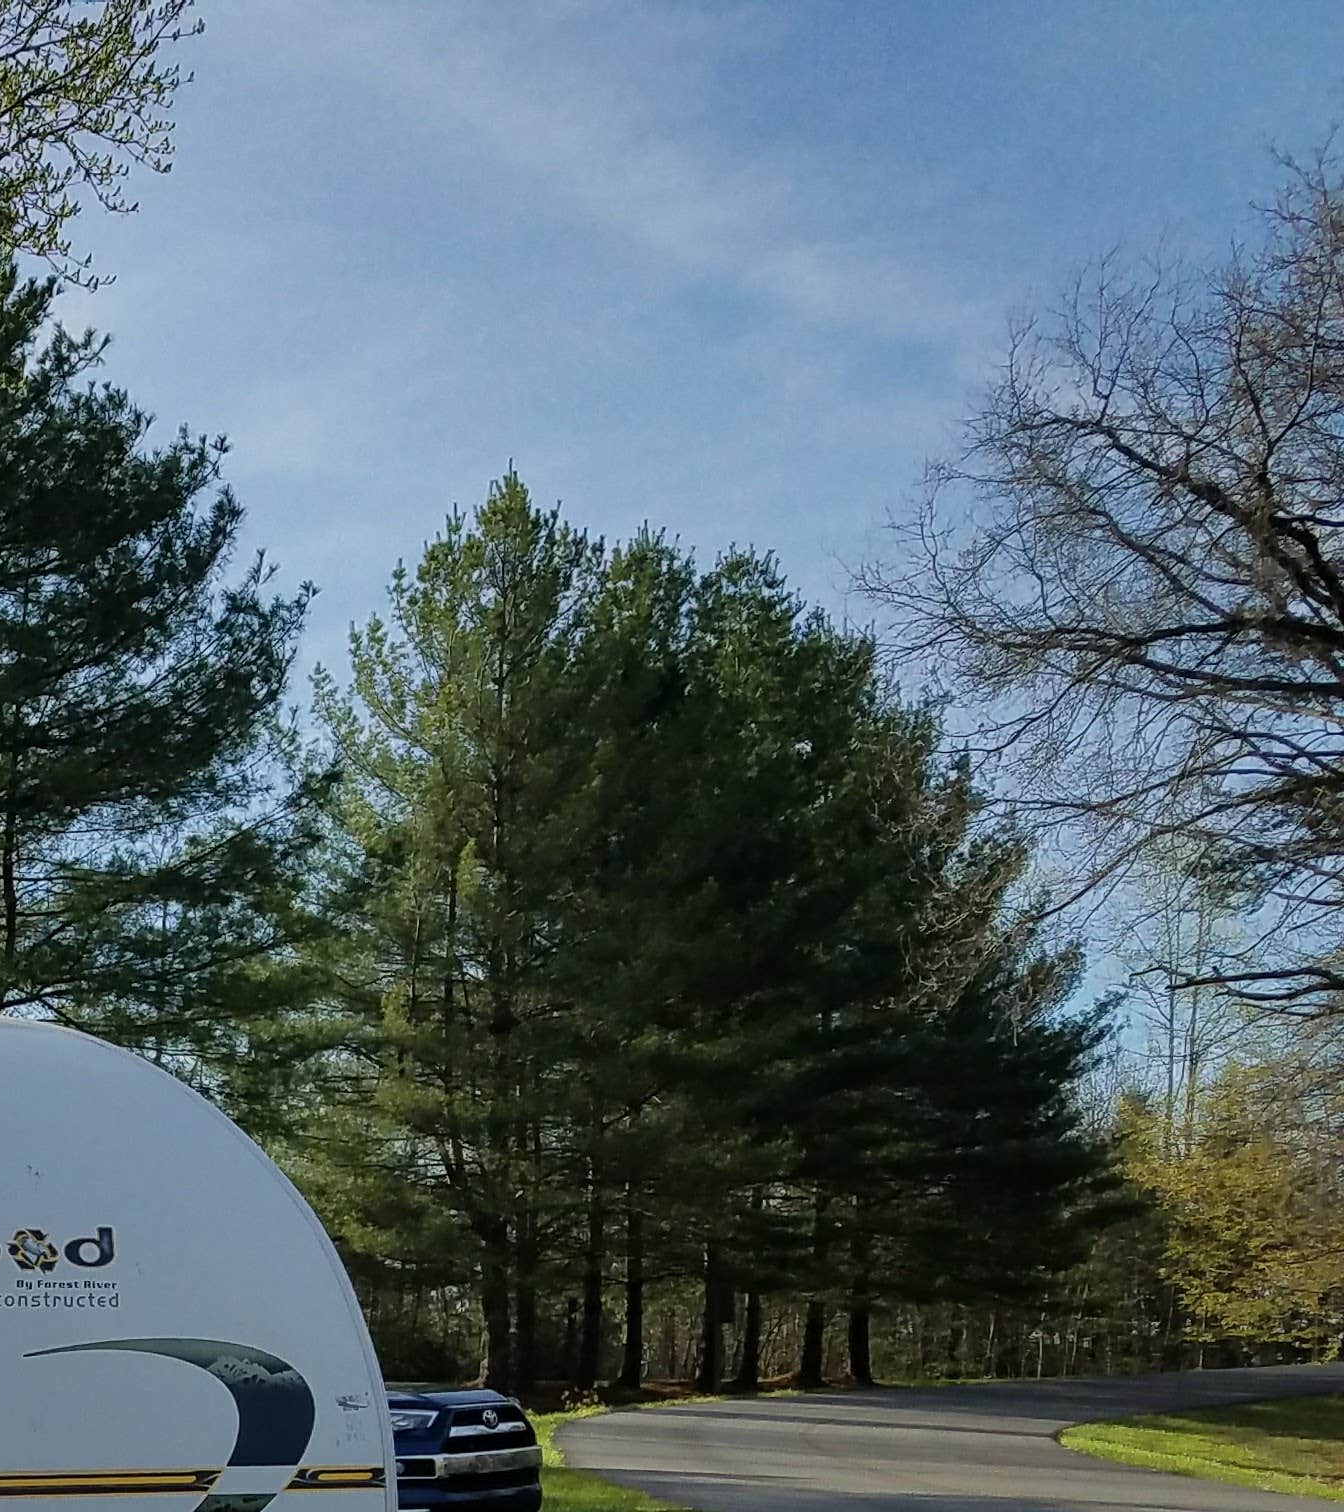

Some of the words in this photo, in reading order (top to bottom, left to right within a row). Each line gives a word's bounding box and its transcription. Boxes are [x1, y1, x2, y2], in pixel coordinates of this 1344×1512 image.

[16, 1280, 33, 1290] By
[37, 1279, 80, 1289] Forest
[83, 1280, 118, 1290] River
